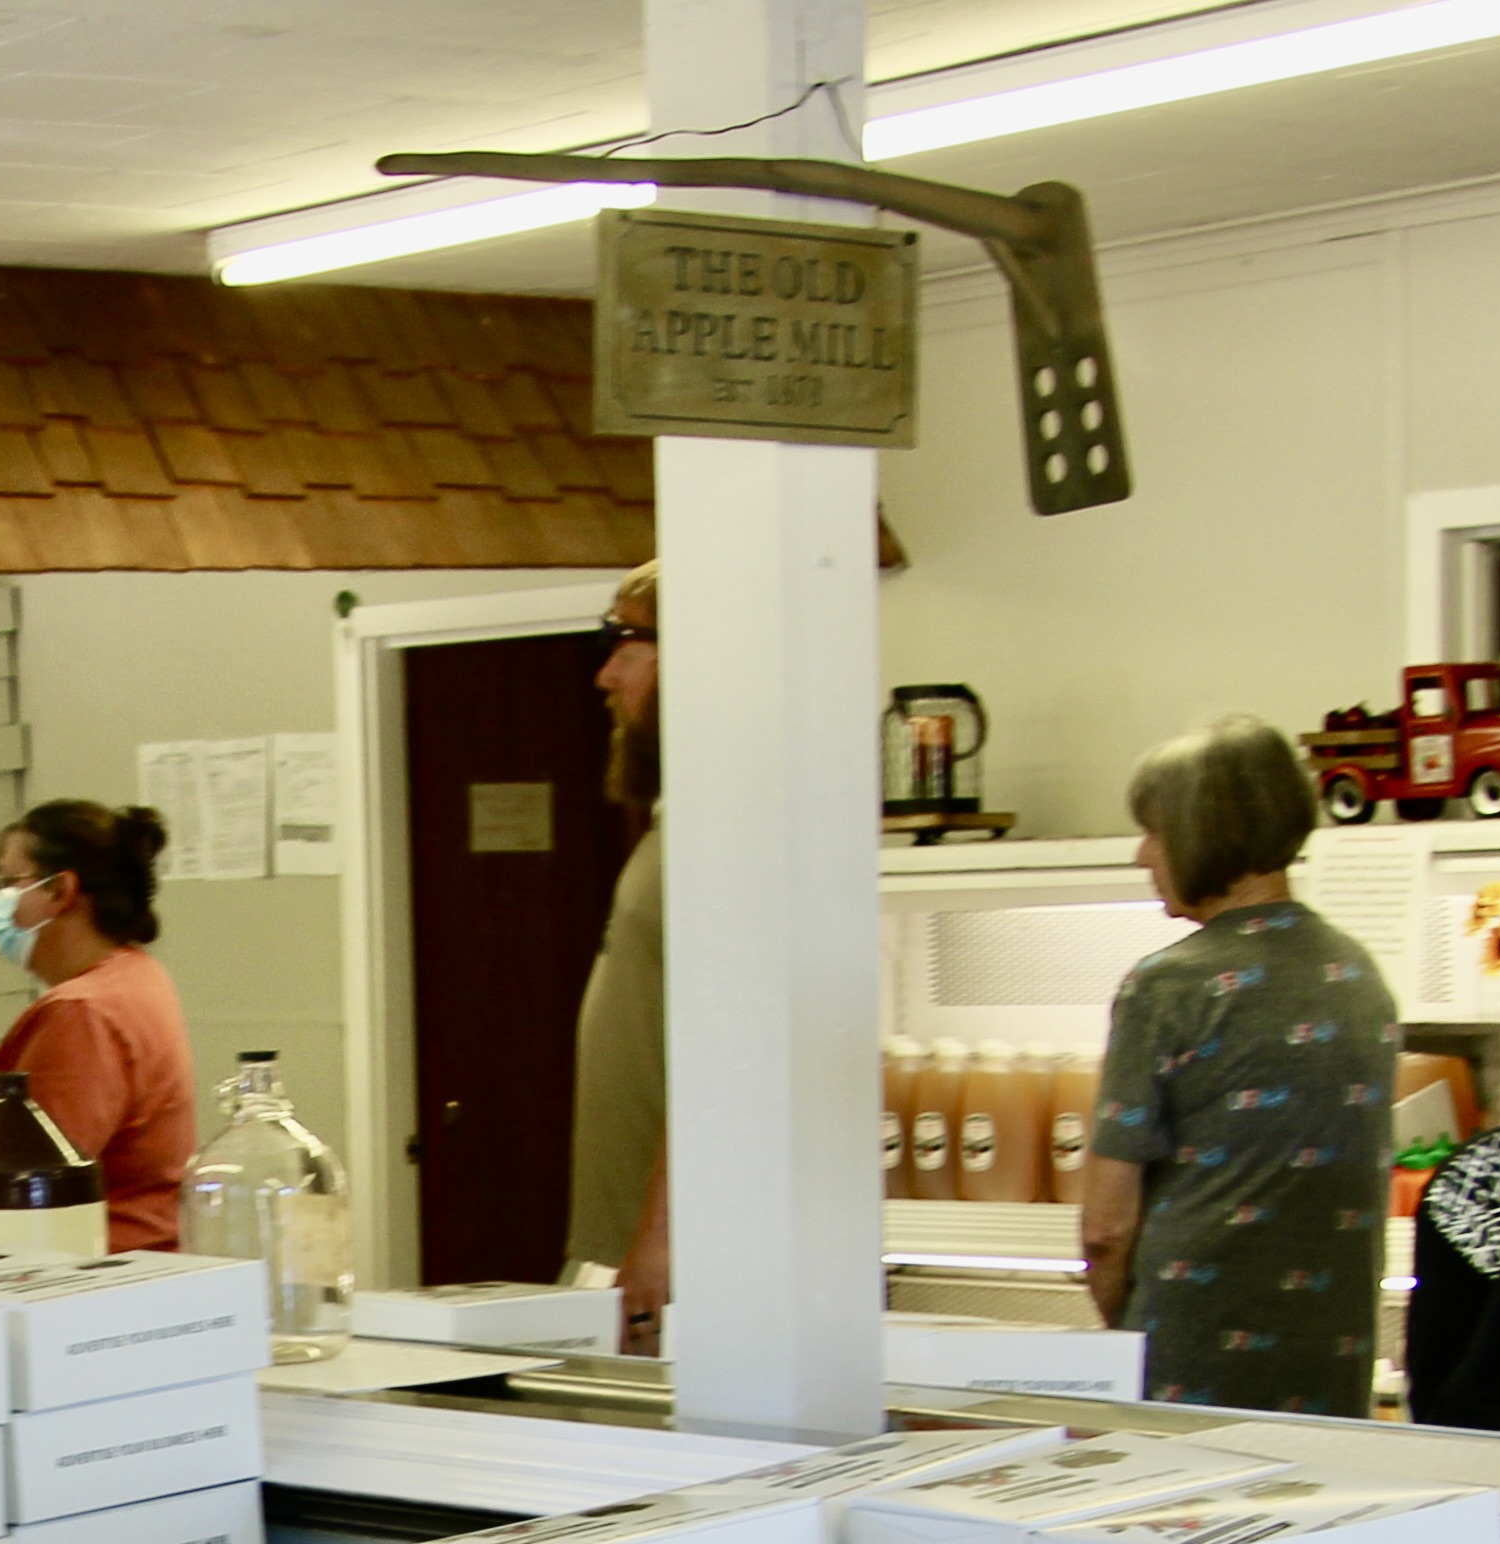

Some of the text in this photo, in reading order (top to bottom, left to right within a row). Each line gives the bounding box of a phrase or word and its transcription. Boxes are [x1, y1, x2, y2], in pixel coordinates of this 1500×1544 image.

[664, 244, 866, 305] THE OLD
[631, 308, 895, 371] APPLE MILL
